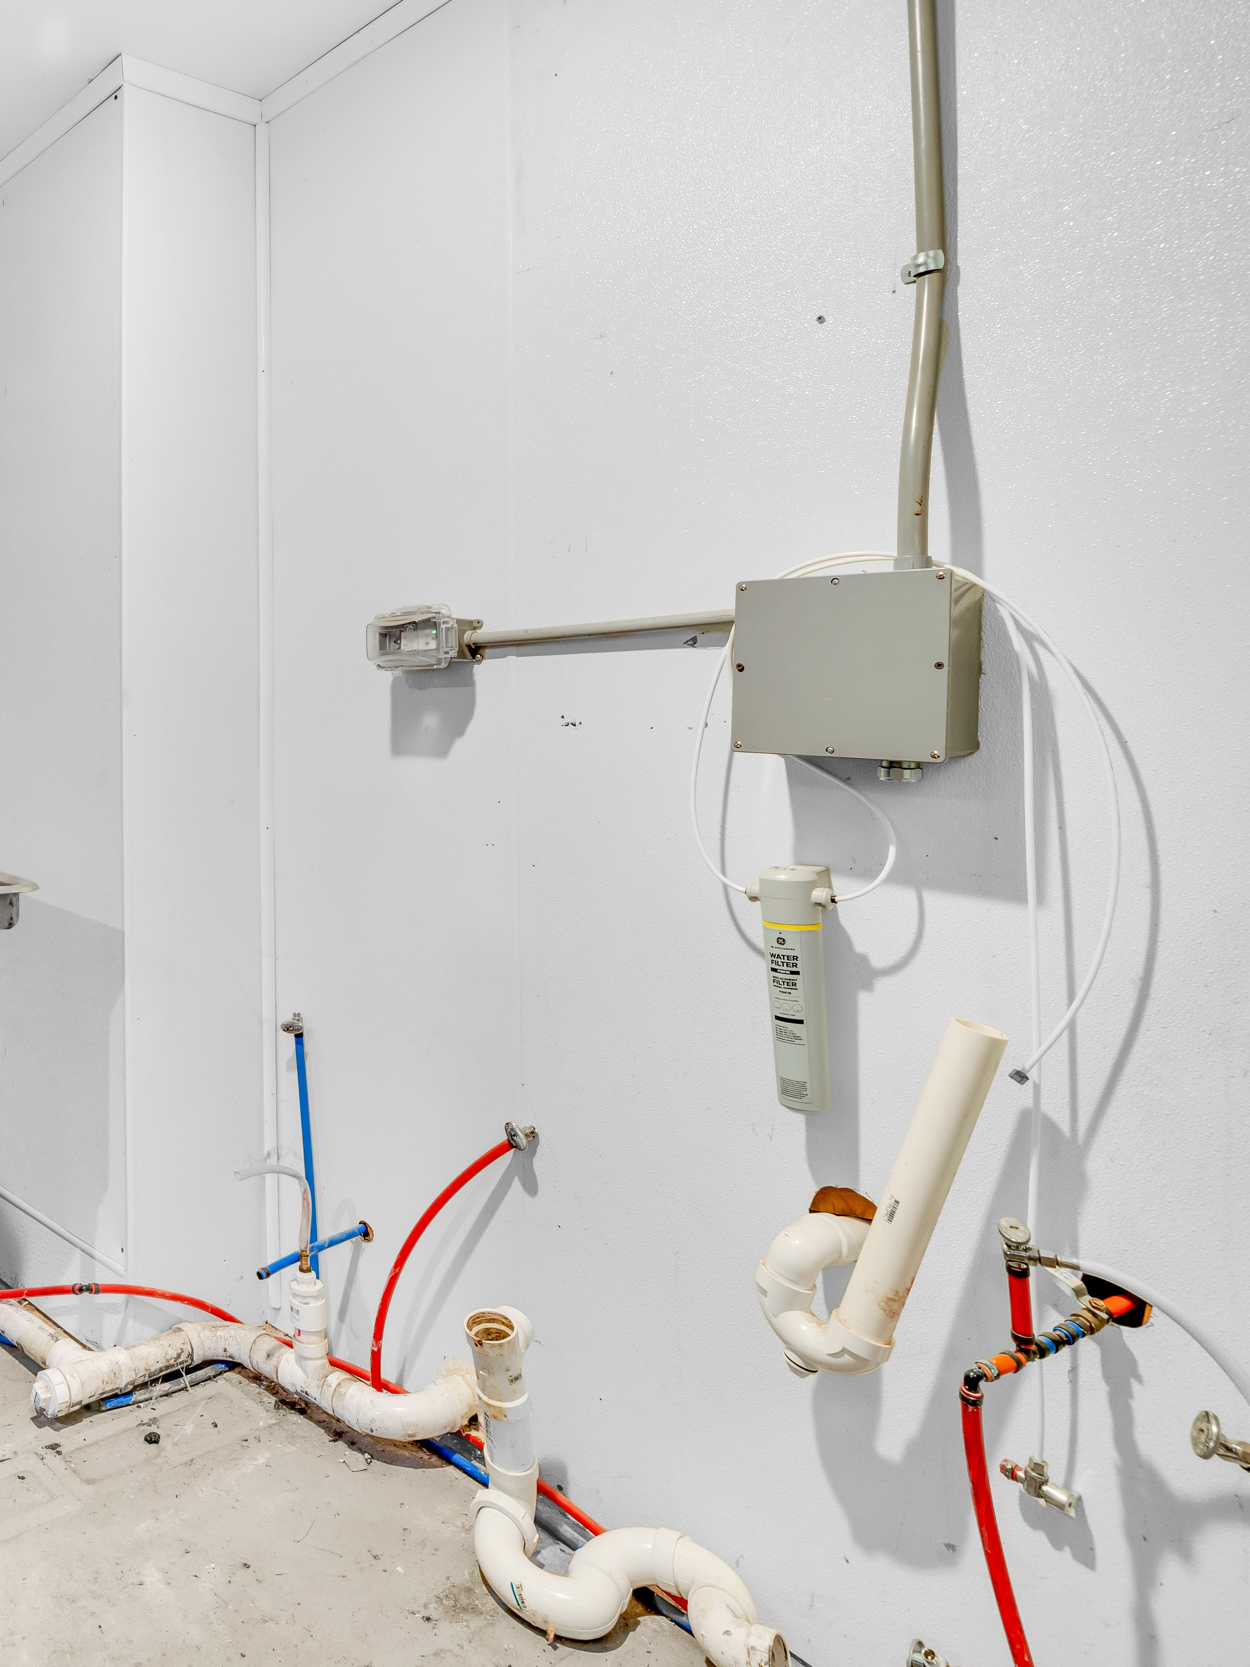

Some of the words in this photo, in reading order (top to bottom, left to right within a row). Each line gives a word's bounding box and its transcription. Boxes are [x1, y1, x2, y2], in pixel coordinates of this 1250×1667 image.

[769, 952, 799, 962] WATER
[770, 959, 798, 969] FILTER
[772, 978, 797, 988] FILTER
